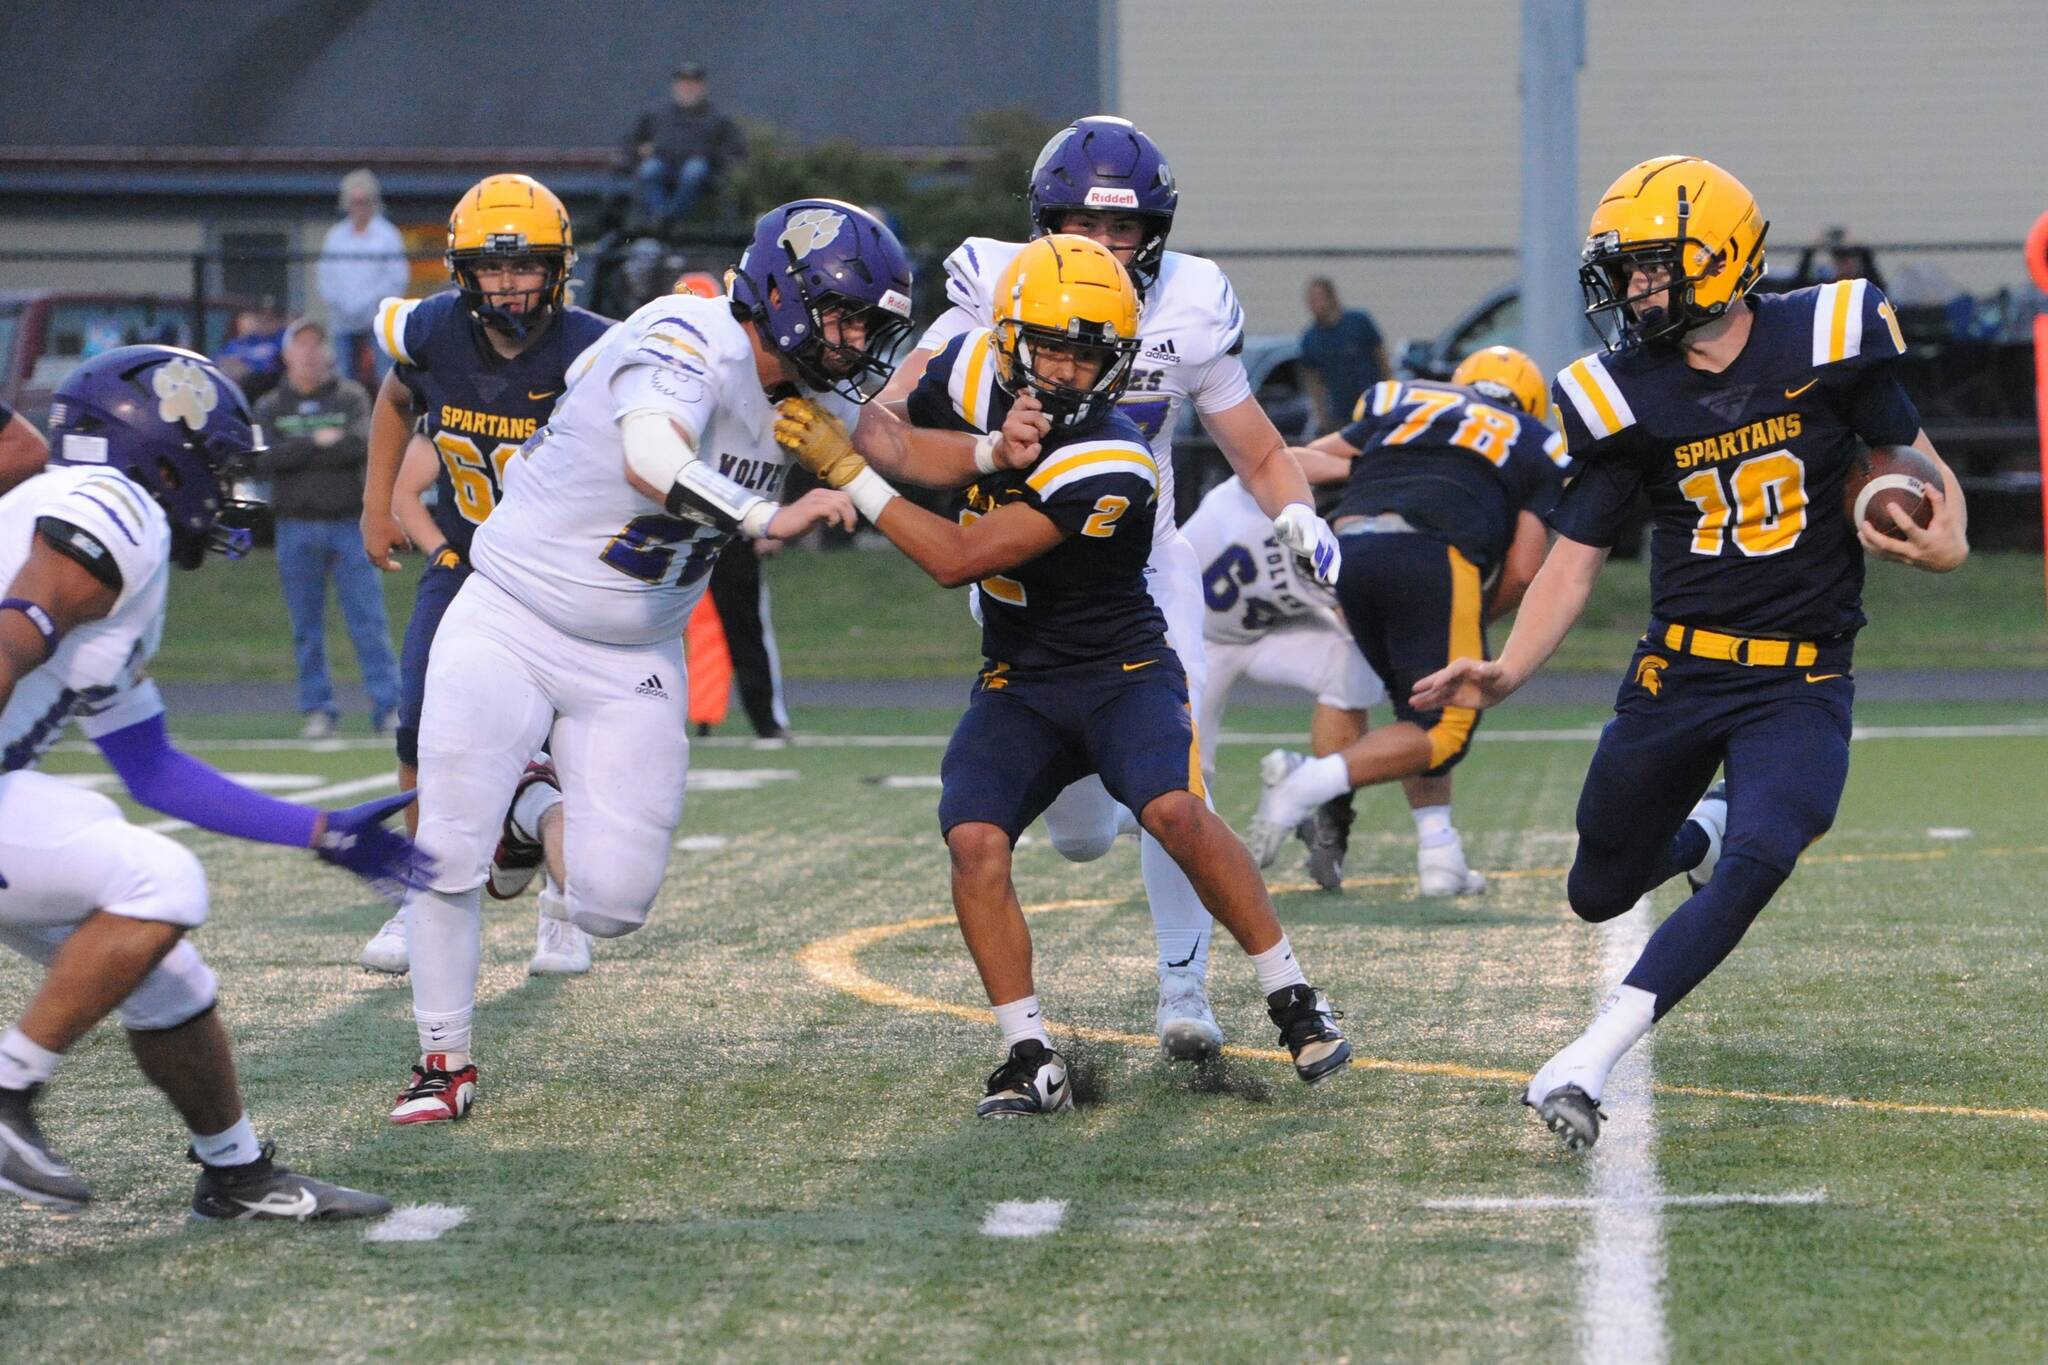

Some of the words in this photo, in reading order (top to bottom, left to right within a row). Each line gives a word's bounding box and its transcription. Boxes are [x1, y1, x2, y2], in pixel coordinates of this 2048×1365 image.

[1091, 193, 1134, 204] Riddell
[1145, 351, 1181, 363] adidas
[441, 404, 537, 439] SPARTANS
[1382, 388, 1521, 468] 78
[1674, 412, 1802, 469] SPARTANS
[433, 430, 522, 526] 6
[718, 453, 783, 493] WOLVE
[1080, 494, 1130, 538] 2
[1678, 449, 1810, 557] 10
[635, 687, 669, 700] adidas
